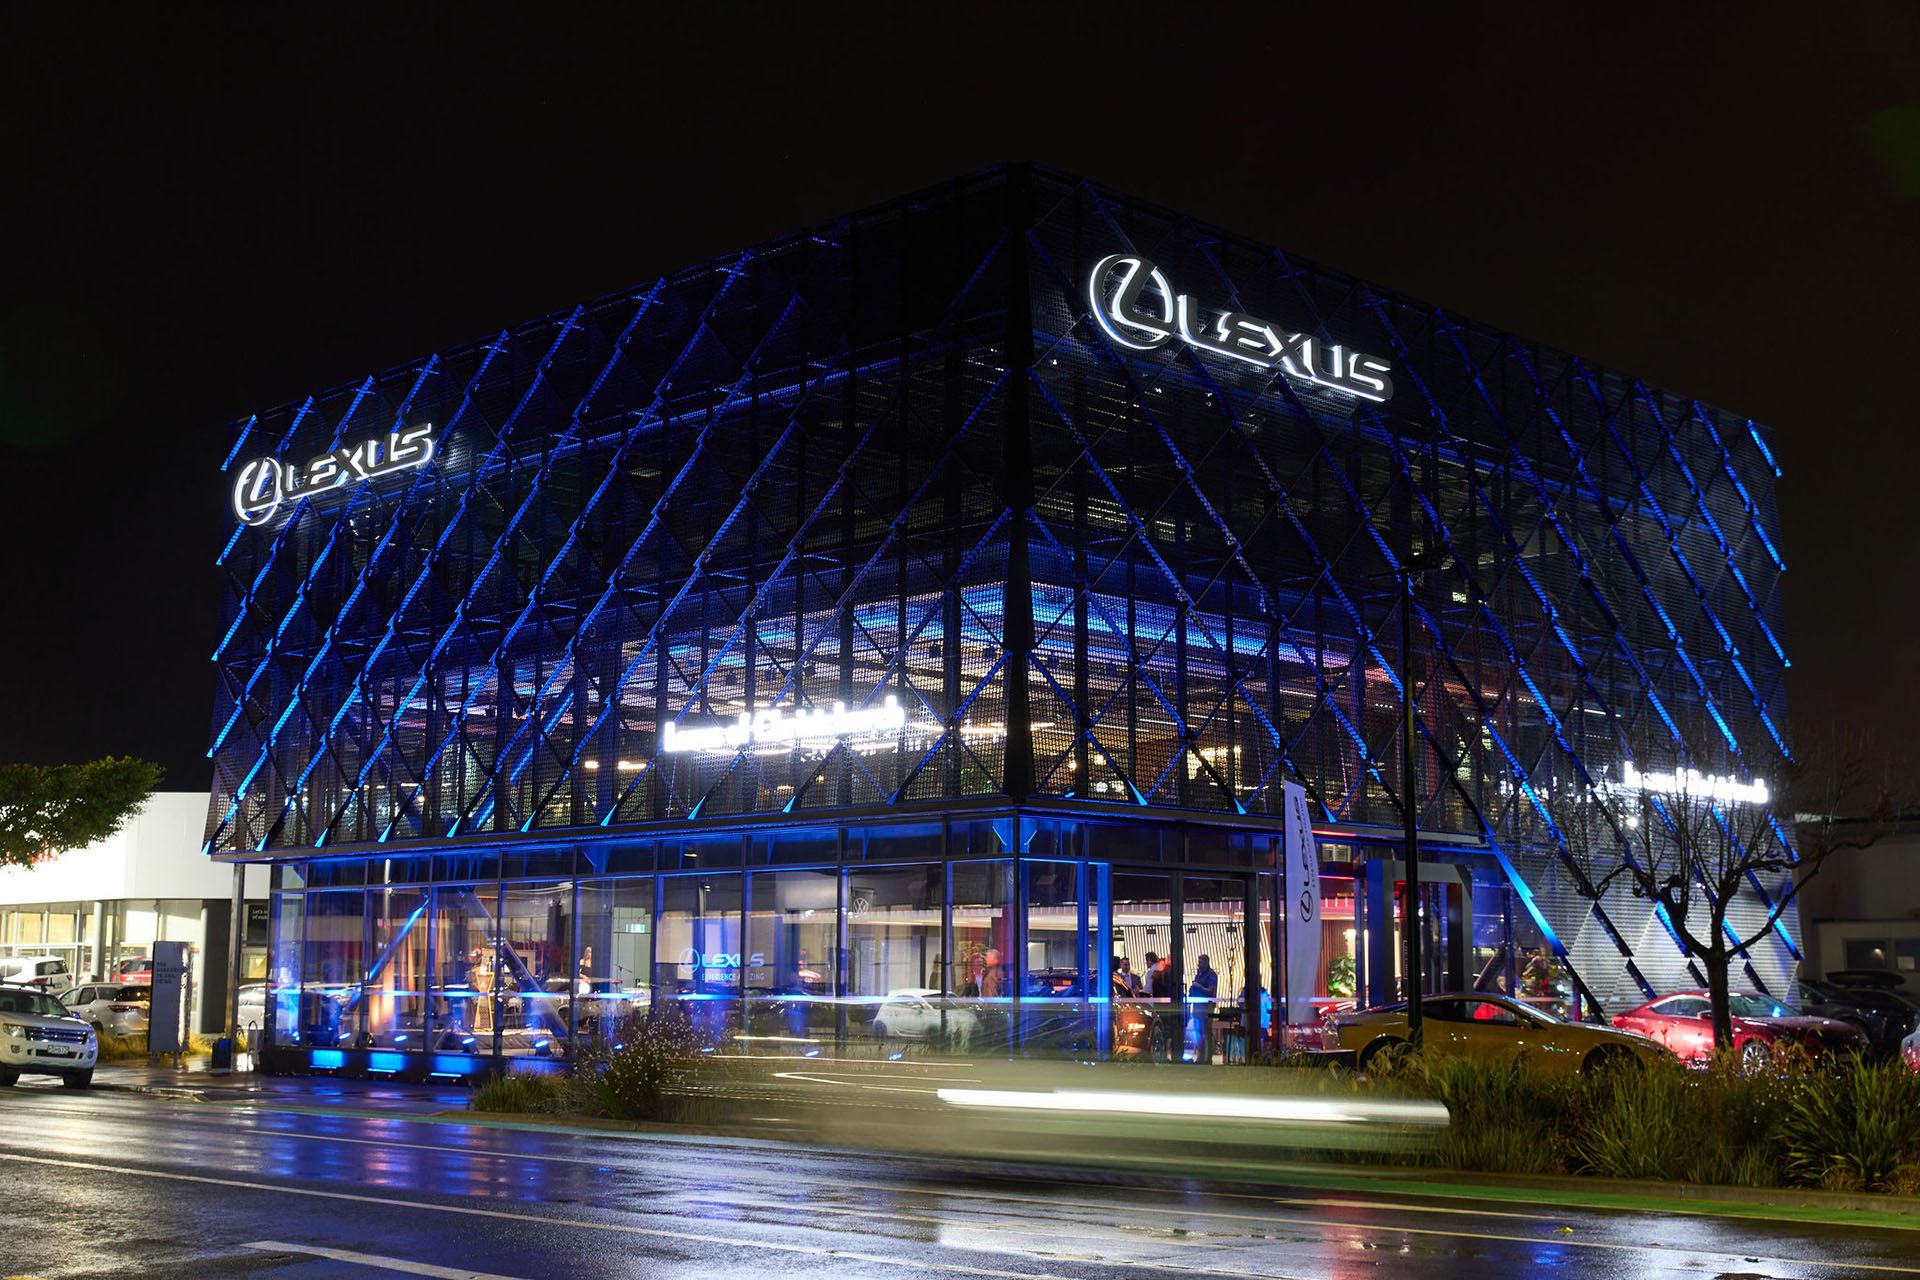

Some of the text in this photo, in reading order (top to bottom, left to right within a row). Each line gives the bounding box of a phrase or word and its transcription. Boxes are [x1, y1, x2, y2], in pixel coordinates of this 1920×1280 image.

[1177, 294, 1393, 402] LEXUS
[281, 422, 435, 500] LEXUS
[702, 953, 764, 967] LEXS
